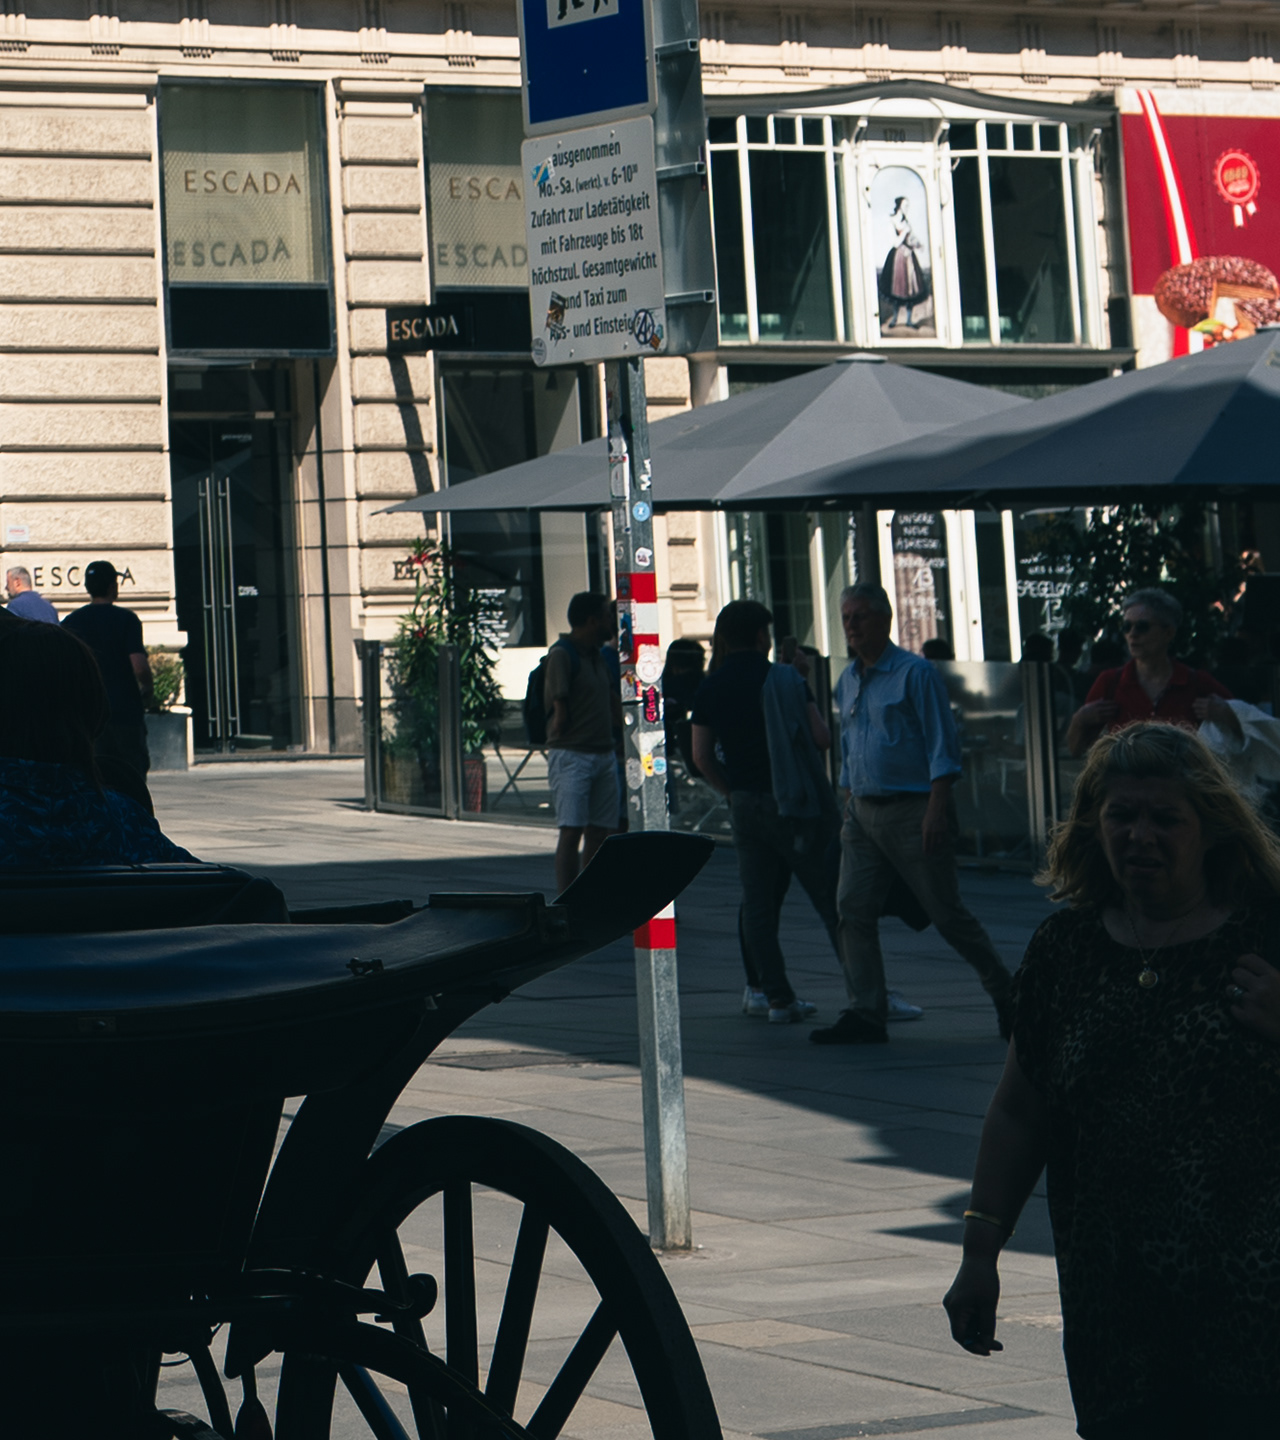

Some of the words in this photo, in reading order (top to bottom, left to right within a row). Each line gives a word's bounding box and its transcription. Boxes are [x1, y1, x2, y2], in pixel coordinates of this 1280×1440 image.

[552, 141, 621, 168] ausgenommen
[185, 170, 300, 194] ESCADA
[449, 177, 522, 200] ESCA
[531, 208, 566, 228] Zufahrt
[568, 206, 584, 222] zur
[586, 191, 650, 219] Ladetätigkeit
[541, 236, 558, 256] mit
[559, 230, 609, 253] Fahrzeuge
[611, 224, 626, 245] bis
[628, 223, 644, 241] 18t
[436, 243, 528, 269] ESCAD
[532, 262, 580, 286] höchstzul.
[582, 252, 658, 278] Gesamtgewicht
[564, 291, 582, 310] und
[584, 286, 604, 307] Taxi
[606, 287, 628, 302] zum
[390, 314, 459, 341] ESCADA
[573, 318, 592, 338] und
[34, 566, 136, 587] ESCA
